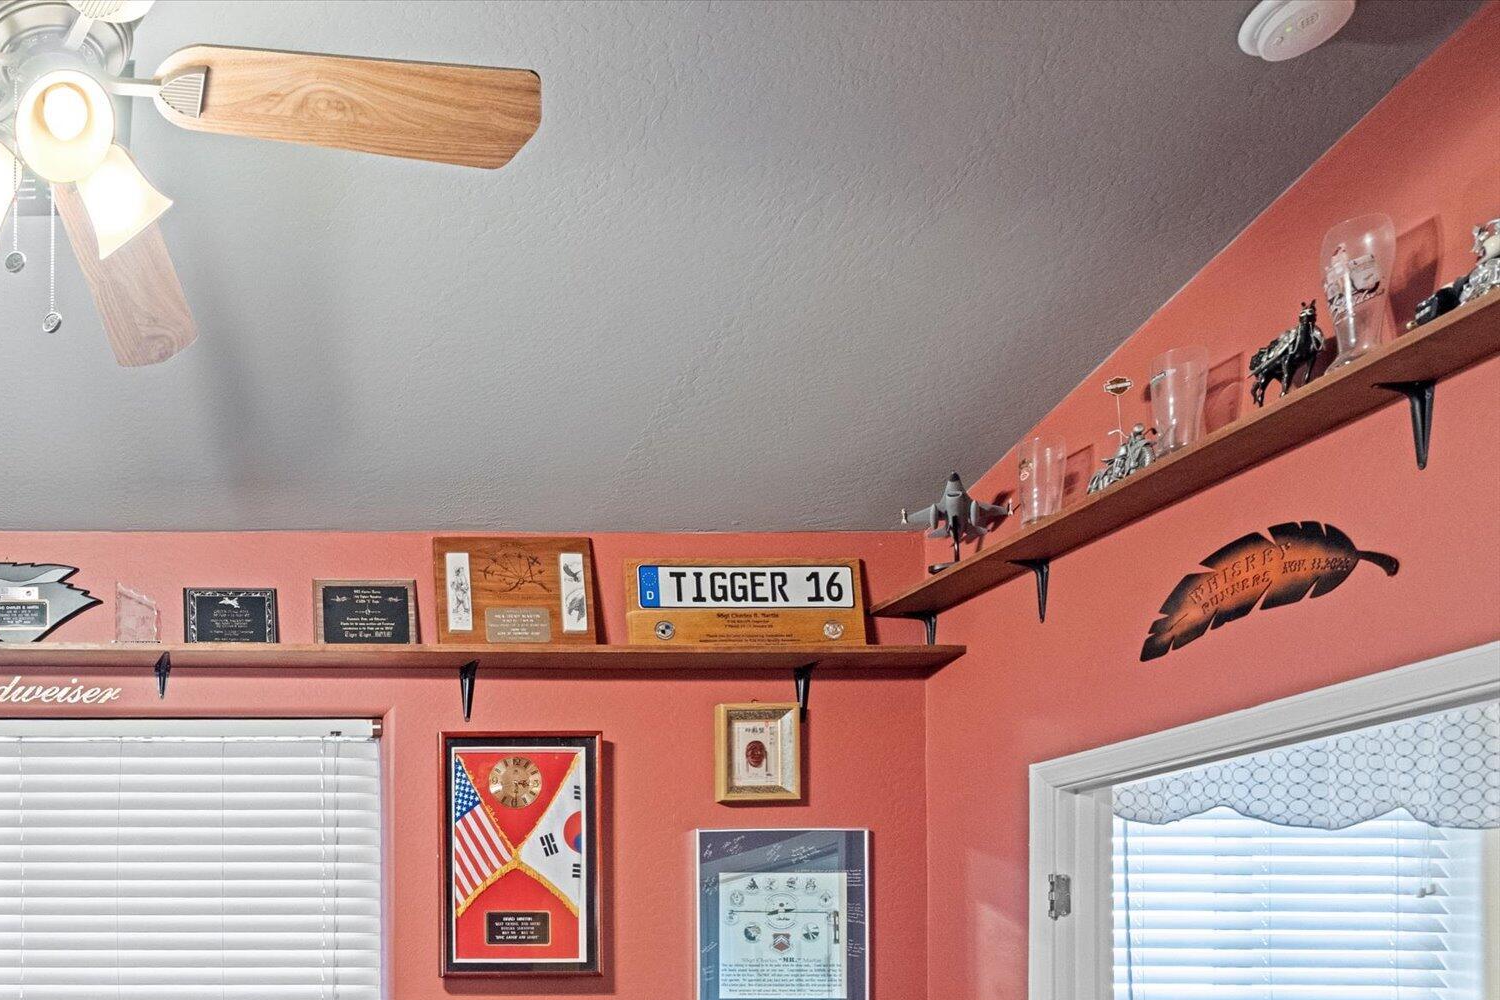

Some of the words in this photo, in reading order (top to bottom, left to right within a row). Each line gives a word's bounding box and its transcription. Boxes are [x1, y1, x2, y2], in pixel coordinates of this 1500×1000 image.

[646, 591, 655, 600] D
[669, 571, 790, 603] TIGGER
[805, 571, 844, 602] 16
